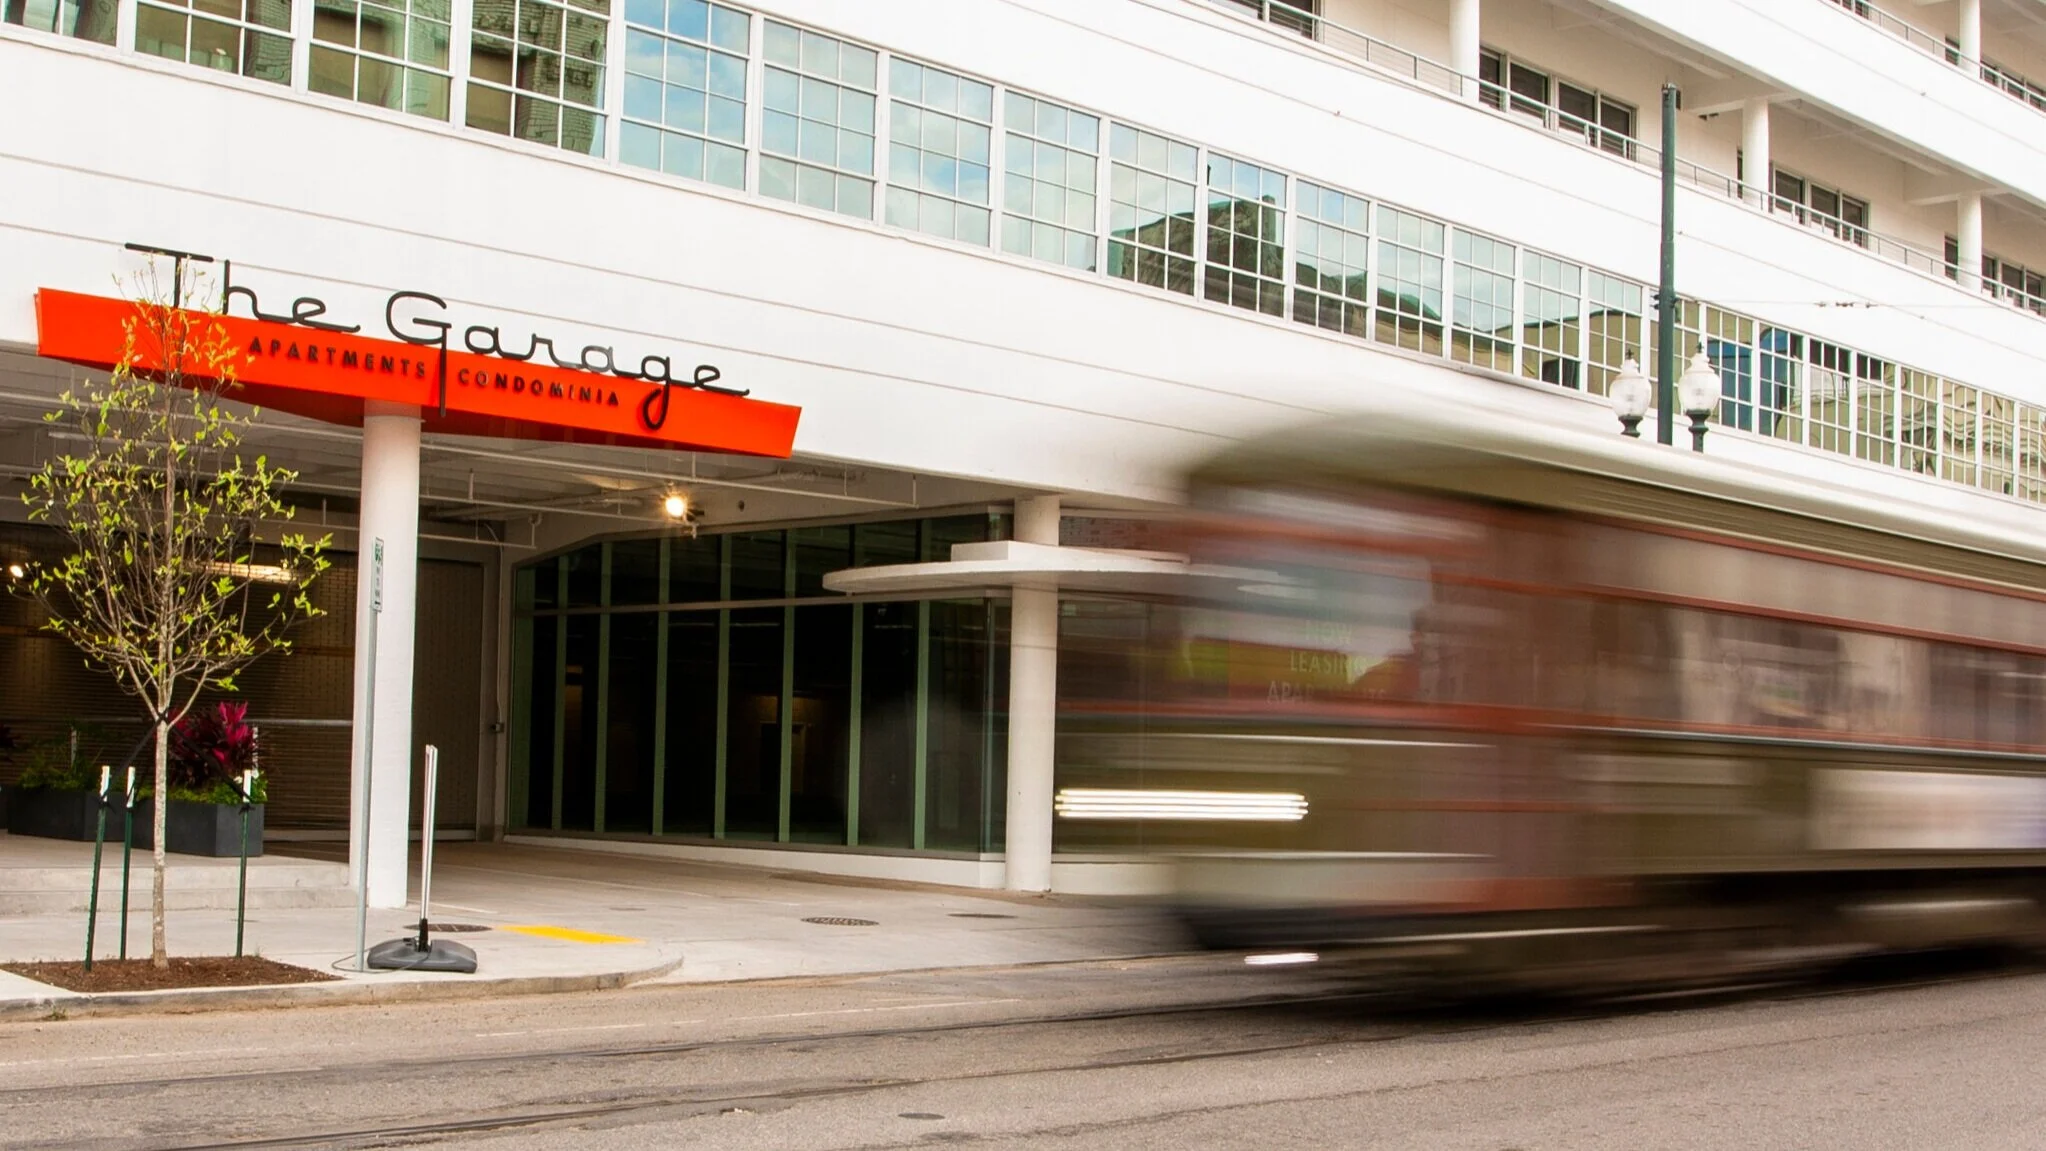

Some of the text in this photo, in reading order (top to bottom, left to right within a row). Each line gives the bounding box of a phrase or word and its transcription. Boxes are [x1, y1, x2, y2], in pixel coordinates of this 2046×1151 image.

[125, 243, 750, 429] The Garage
[250, 337, 620, 406] APARTMENTS CONDOMINIA
